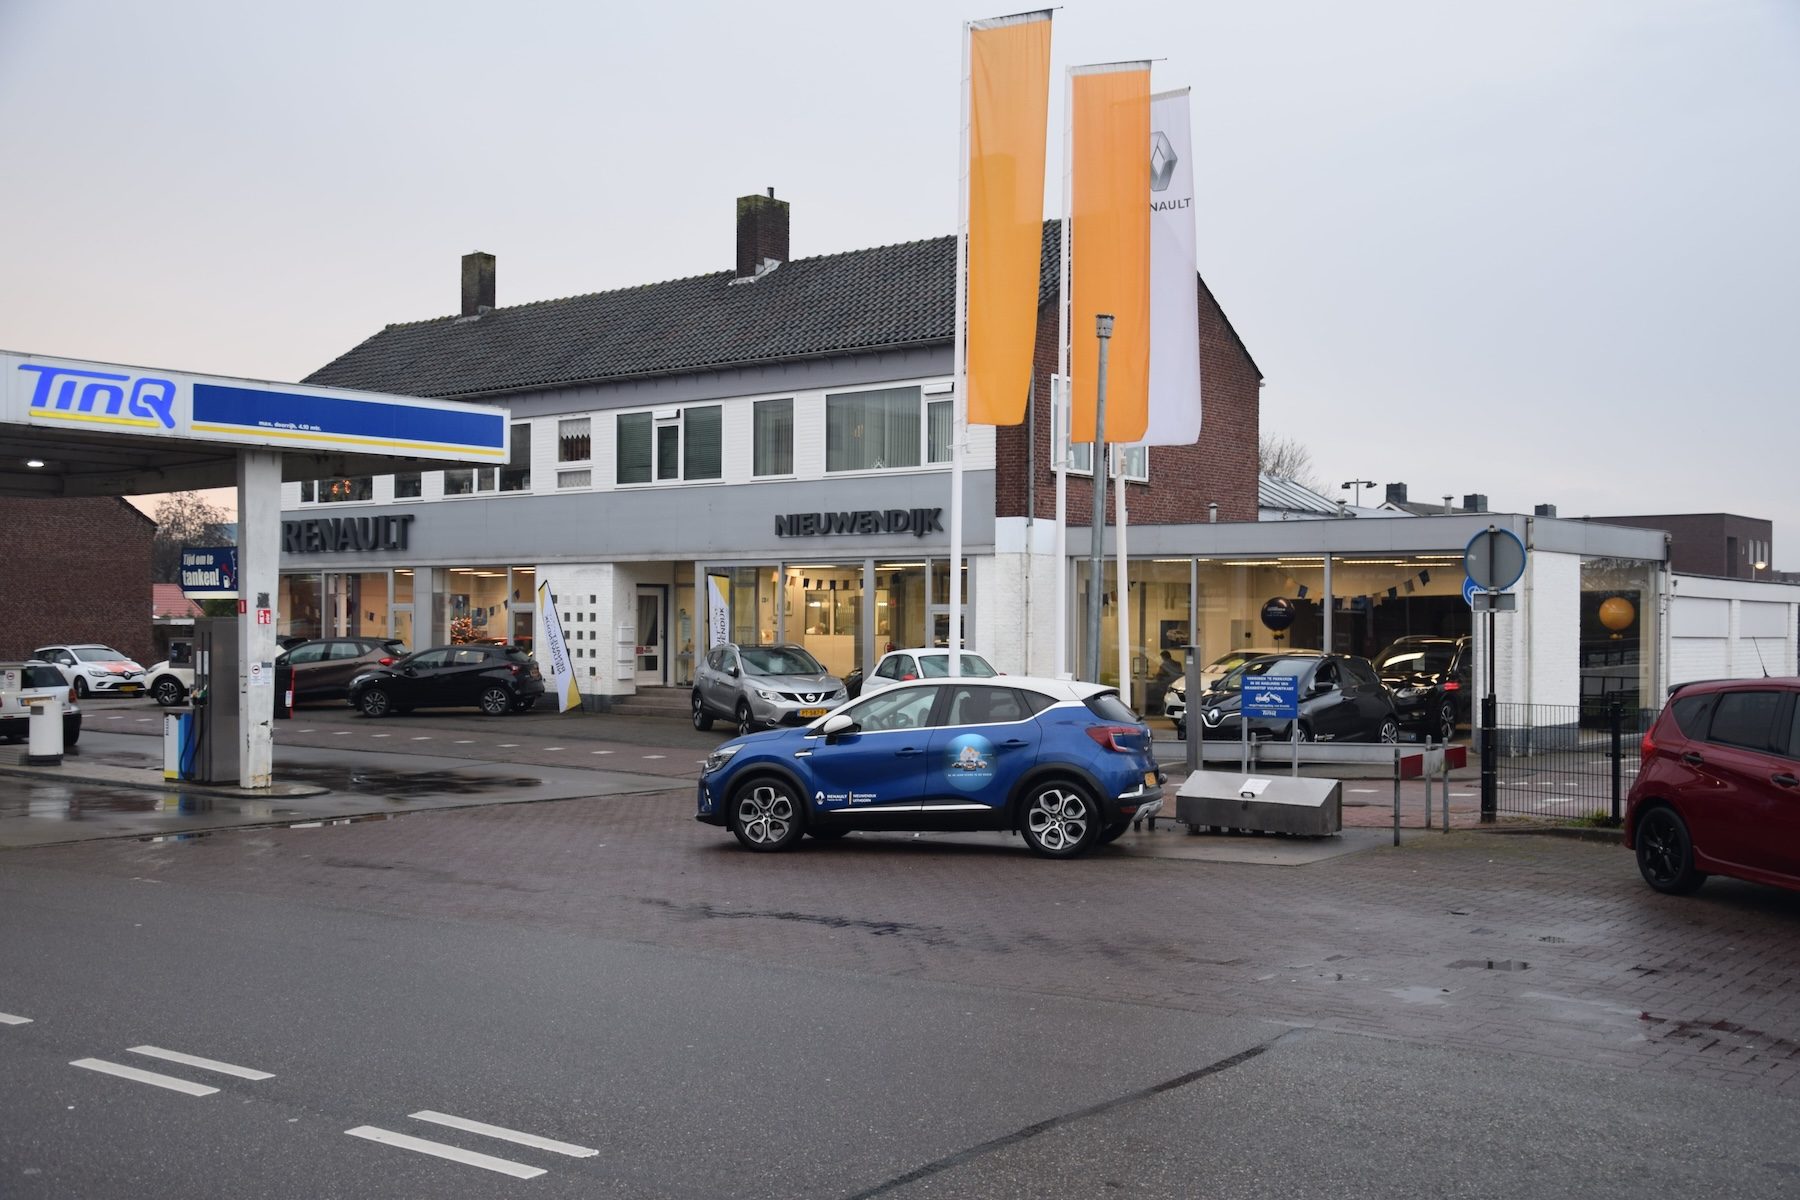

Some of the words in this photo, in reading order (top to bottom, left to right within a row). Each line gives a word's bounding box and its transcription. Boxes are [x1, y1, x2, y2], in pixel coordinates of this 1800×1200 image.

[1150, 197, 1192, 212] NAULT
[774, 508, 944, 538] NIEUWENDIJK
[281, 514, 415, 554] RENAULT
[183, 554, 196, 566] Tijd
[196, 555, 206, 565] om
[206, 554, 214, 565] te
[182, 568, 220, 586] tanken!
